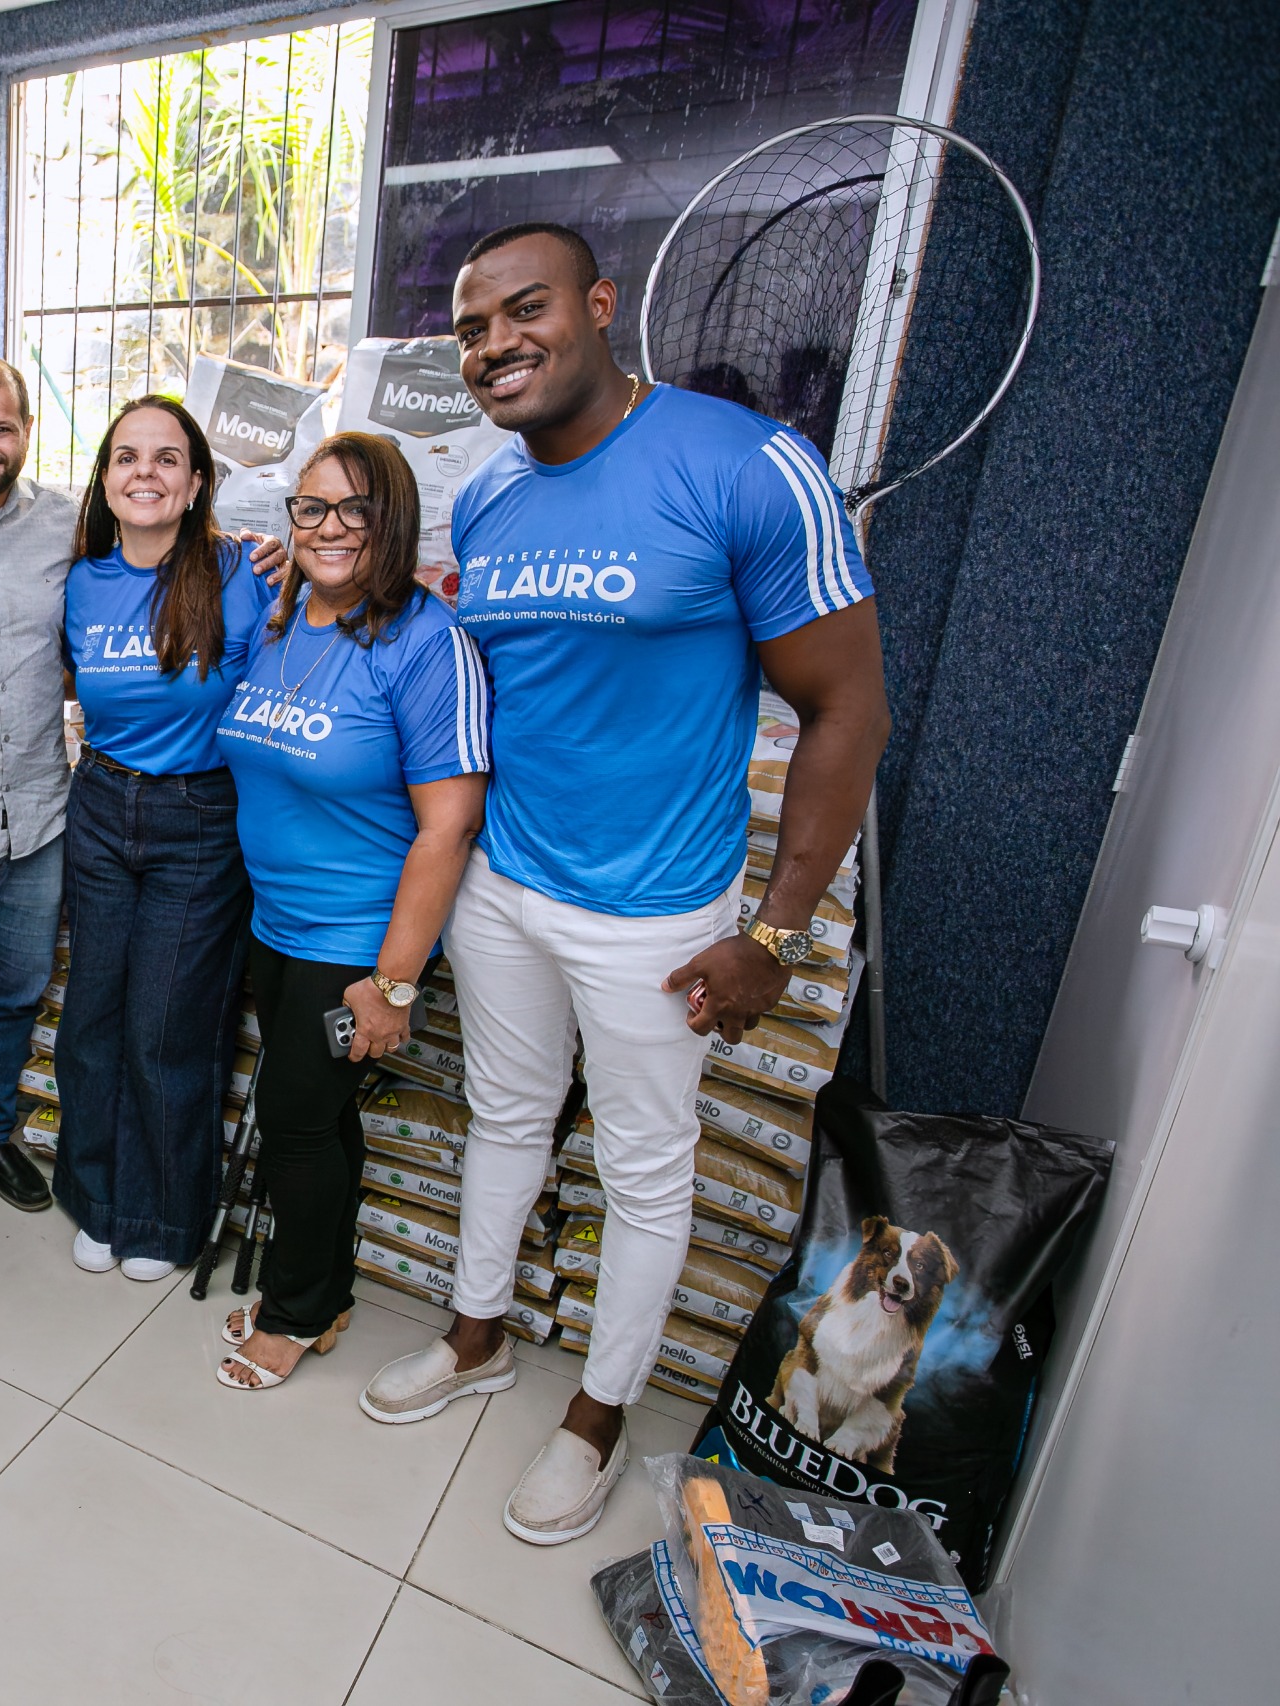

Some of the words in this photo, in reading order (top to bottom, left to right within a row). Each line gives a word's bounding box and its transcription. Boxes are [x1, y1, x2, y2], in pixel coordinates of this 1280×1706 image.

[382, 382, 476, 414] Monello
[215, 411, 293, 449] Monell
[496, 548, 638, 566] PREFEITURA
[486, 563, 636, 602] LAURO
[458, 609, 512, 624] Construindo
[513, 610, 538, 620] uma
[540, 609, 567, 620] nova
[569, 609, 626, 624] história
[103, 635, 158, 659] LAU
[121, 665, 141, 673] uma
[249, 686, 339, 713] PREFEITURA
[233, 695, 333, 742] LAURO
[245, 733, 263, 744] uma
[280, 741, 317, 760] história
[695, 1099, 721, 1118] ello
[418, 1180, 462, 1204] Monell
[659, 1343, 697, 1365] nello
[653, 1363, 700, 1388] onello
[730, 1380, 949, 1531] BLUEDOG
[752, 1441, 789, 1475] PREMIUM
[791, 1551, 803, 1561] 42
[809, 1557, 818, 1569] 41
[819, 1565, 830, 1577] 40
[855, 1577, 869, 1588] 38
[875, 1582, 890, 1592] 37
[953, 1601, 969, 1612] 33
